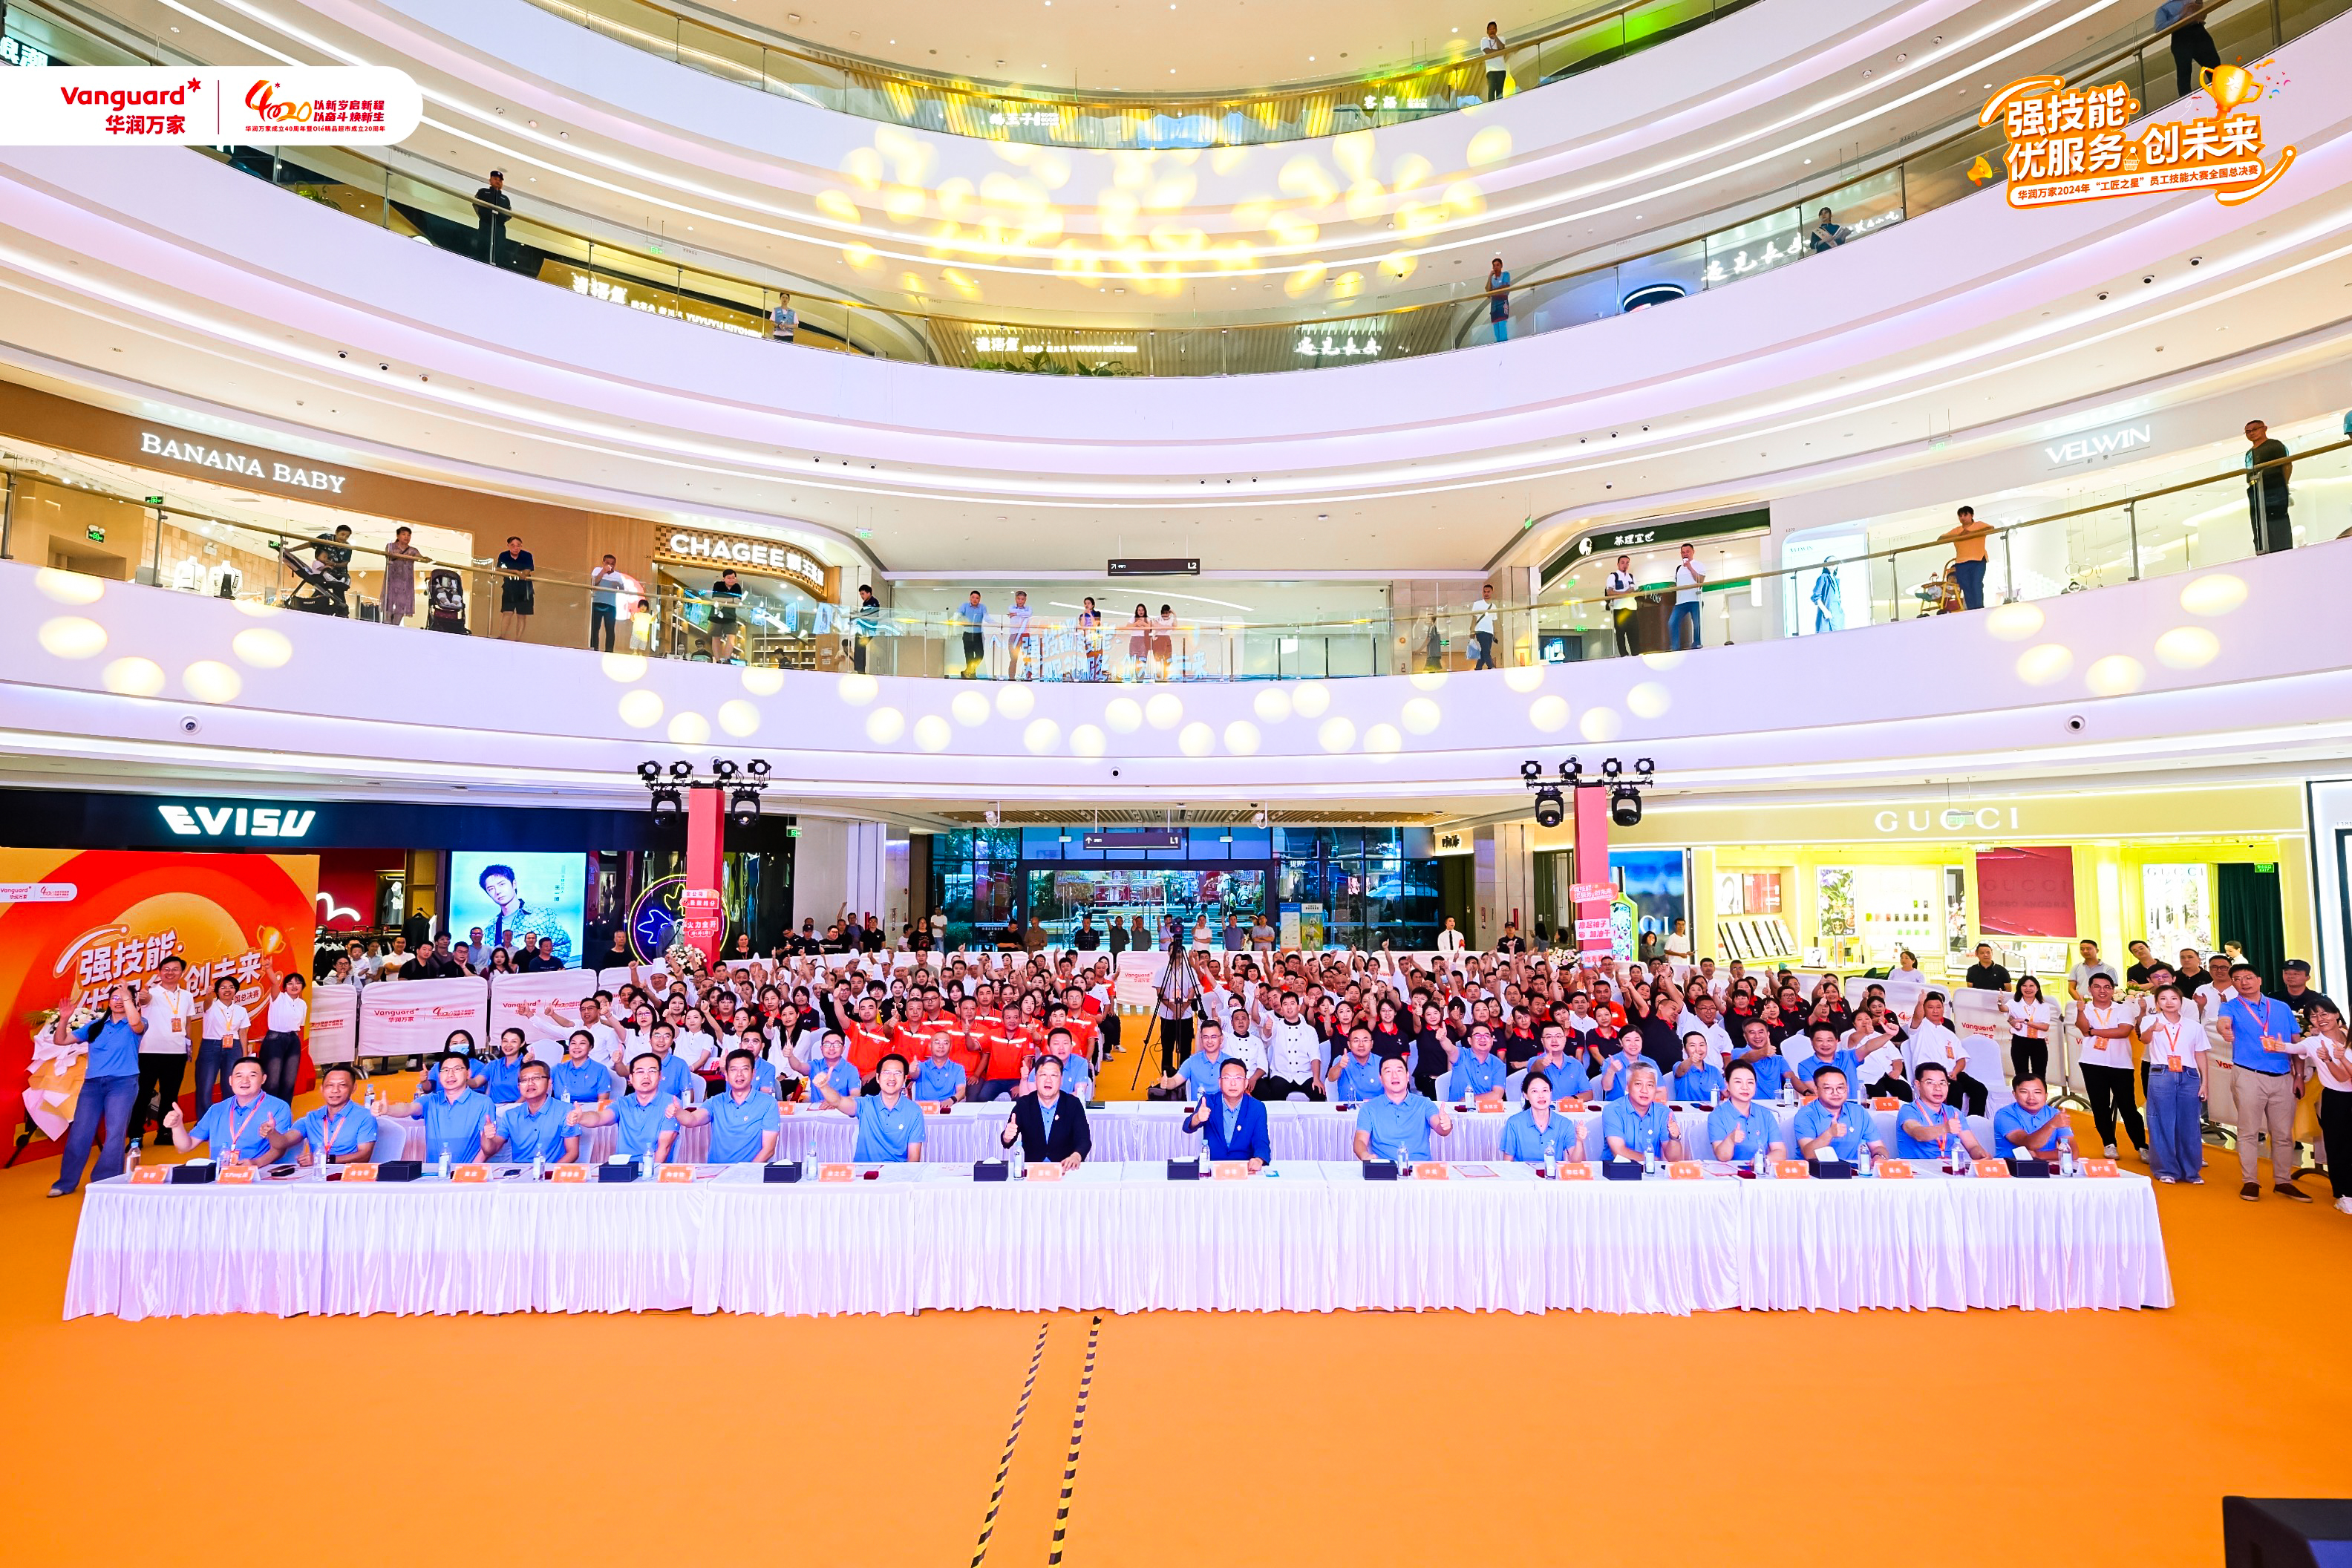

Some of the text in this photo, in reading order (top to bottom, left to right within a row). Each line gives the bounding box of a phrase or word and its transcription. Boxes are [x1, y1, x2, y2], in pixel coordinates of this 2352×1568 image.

[2044, 424, 2151, 464] VELWIN
[140, 432, 346, 494] BANANA BABY
[670, 534, 785, 568] CHAGEE
[157, 805, 316, 837] EVISU
[1874, 807, 2019, 832] GUCCI
[1169, 837, 1179, 845] L1
[687, 921, 716, 929] 火力全开
[373, 1008, 415, 1016] Vanguard
[1961, 1022, 1994, 1032] Vanguard
